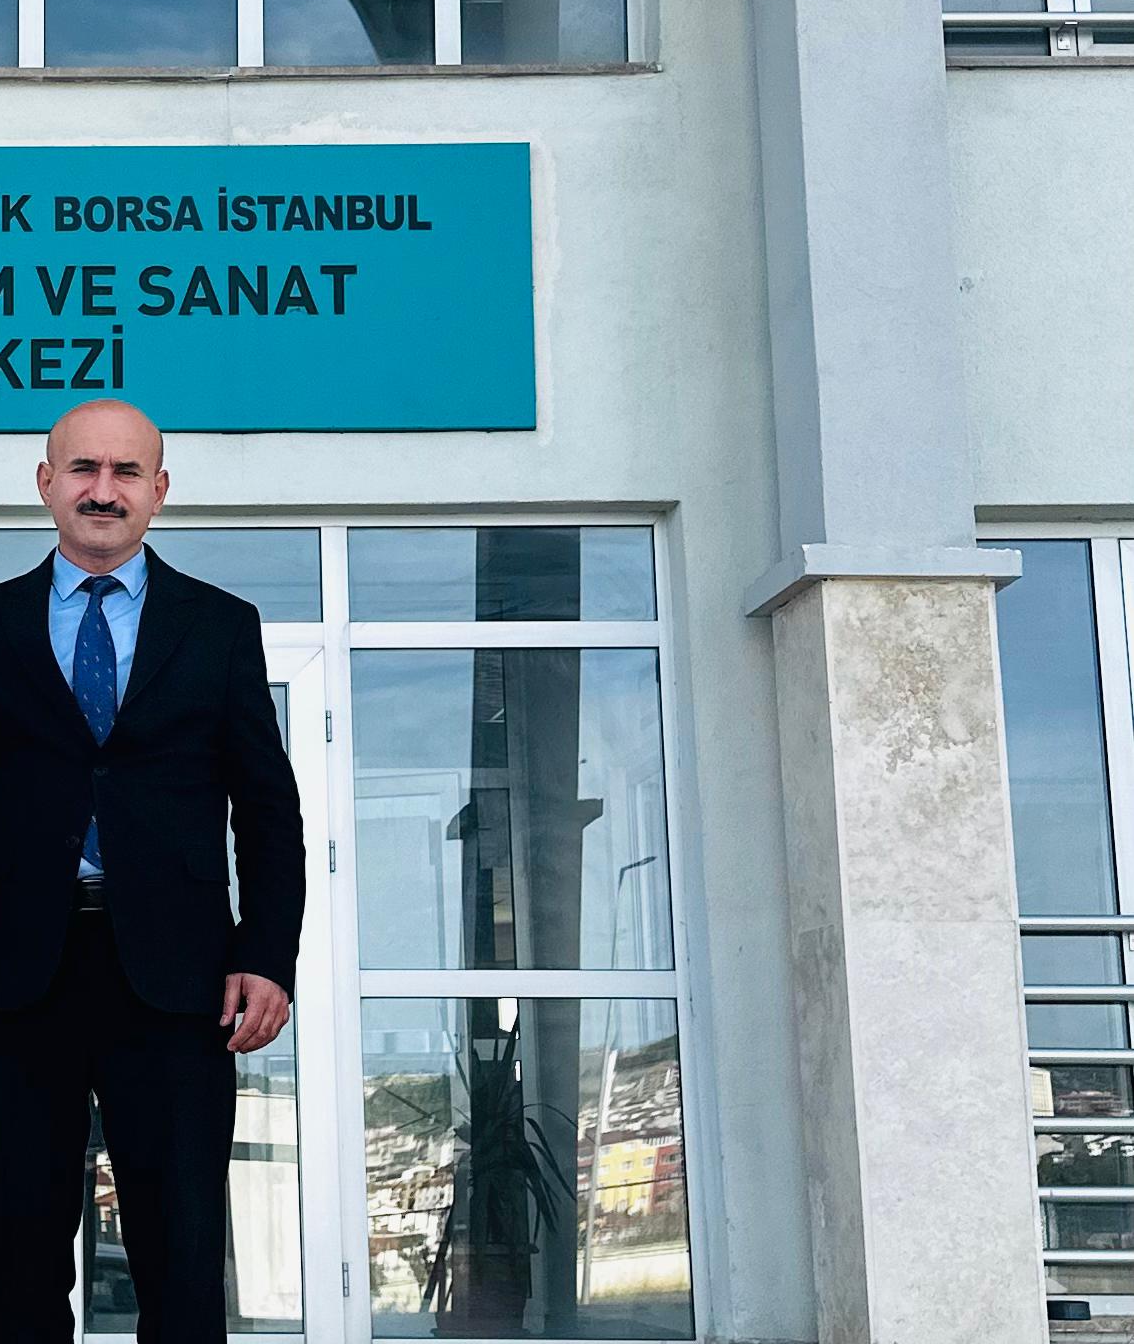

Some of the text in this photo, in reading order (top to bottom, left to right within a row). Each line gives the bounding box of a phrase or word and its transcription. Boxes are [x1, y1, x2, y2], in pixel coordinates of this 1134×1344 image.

[54, 195, 204, 233] BORSA
[218, 186, 433, 233] İSTANBUL
[35, 264, 118, 317] VE
[137, 263, 358, 318] SANAT
